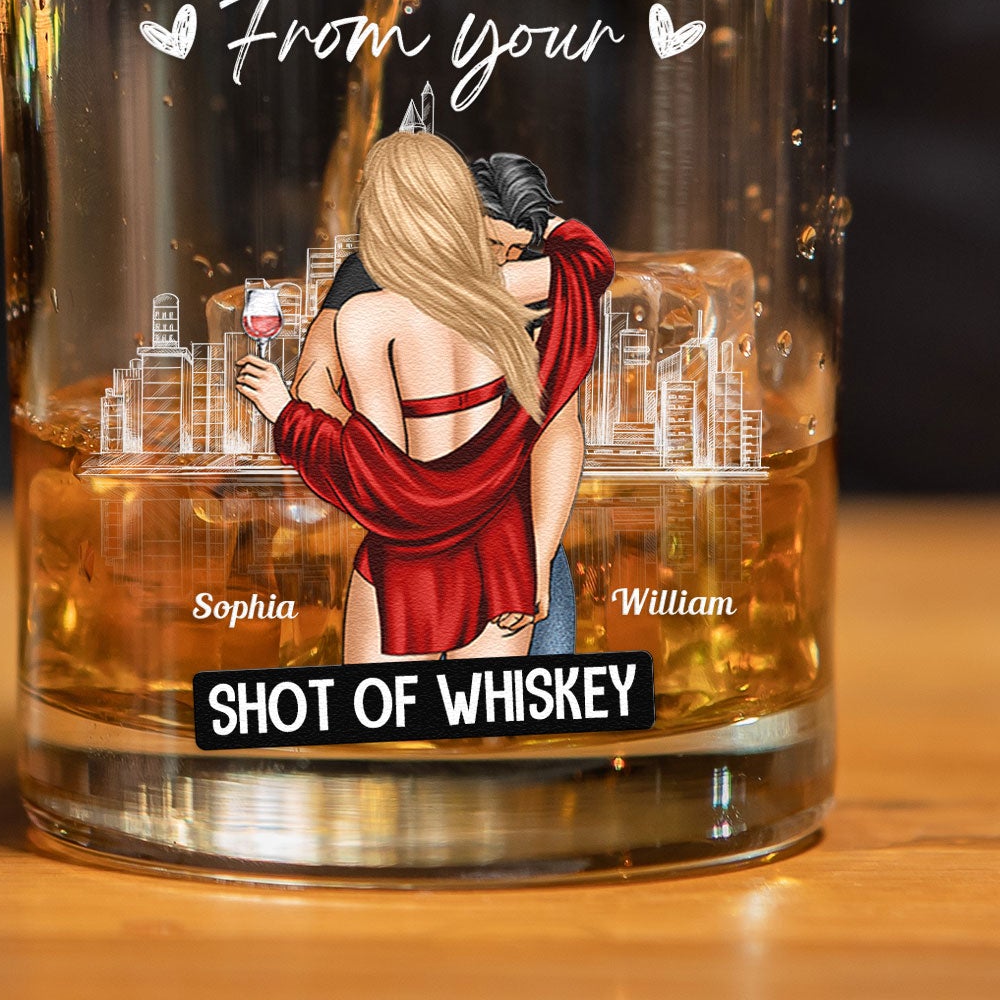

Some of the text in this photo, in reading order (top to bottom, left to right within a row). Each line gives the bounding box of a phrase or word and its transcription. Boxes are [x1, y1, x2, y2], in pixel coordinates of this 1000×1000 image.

[451, 12, 625, 112] your
[192, 592, 299, 628] Sophia
[611, 587, 737, 617] William
[208, 663, 637, 736] SHOT OF WHISKEY
